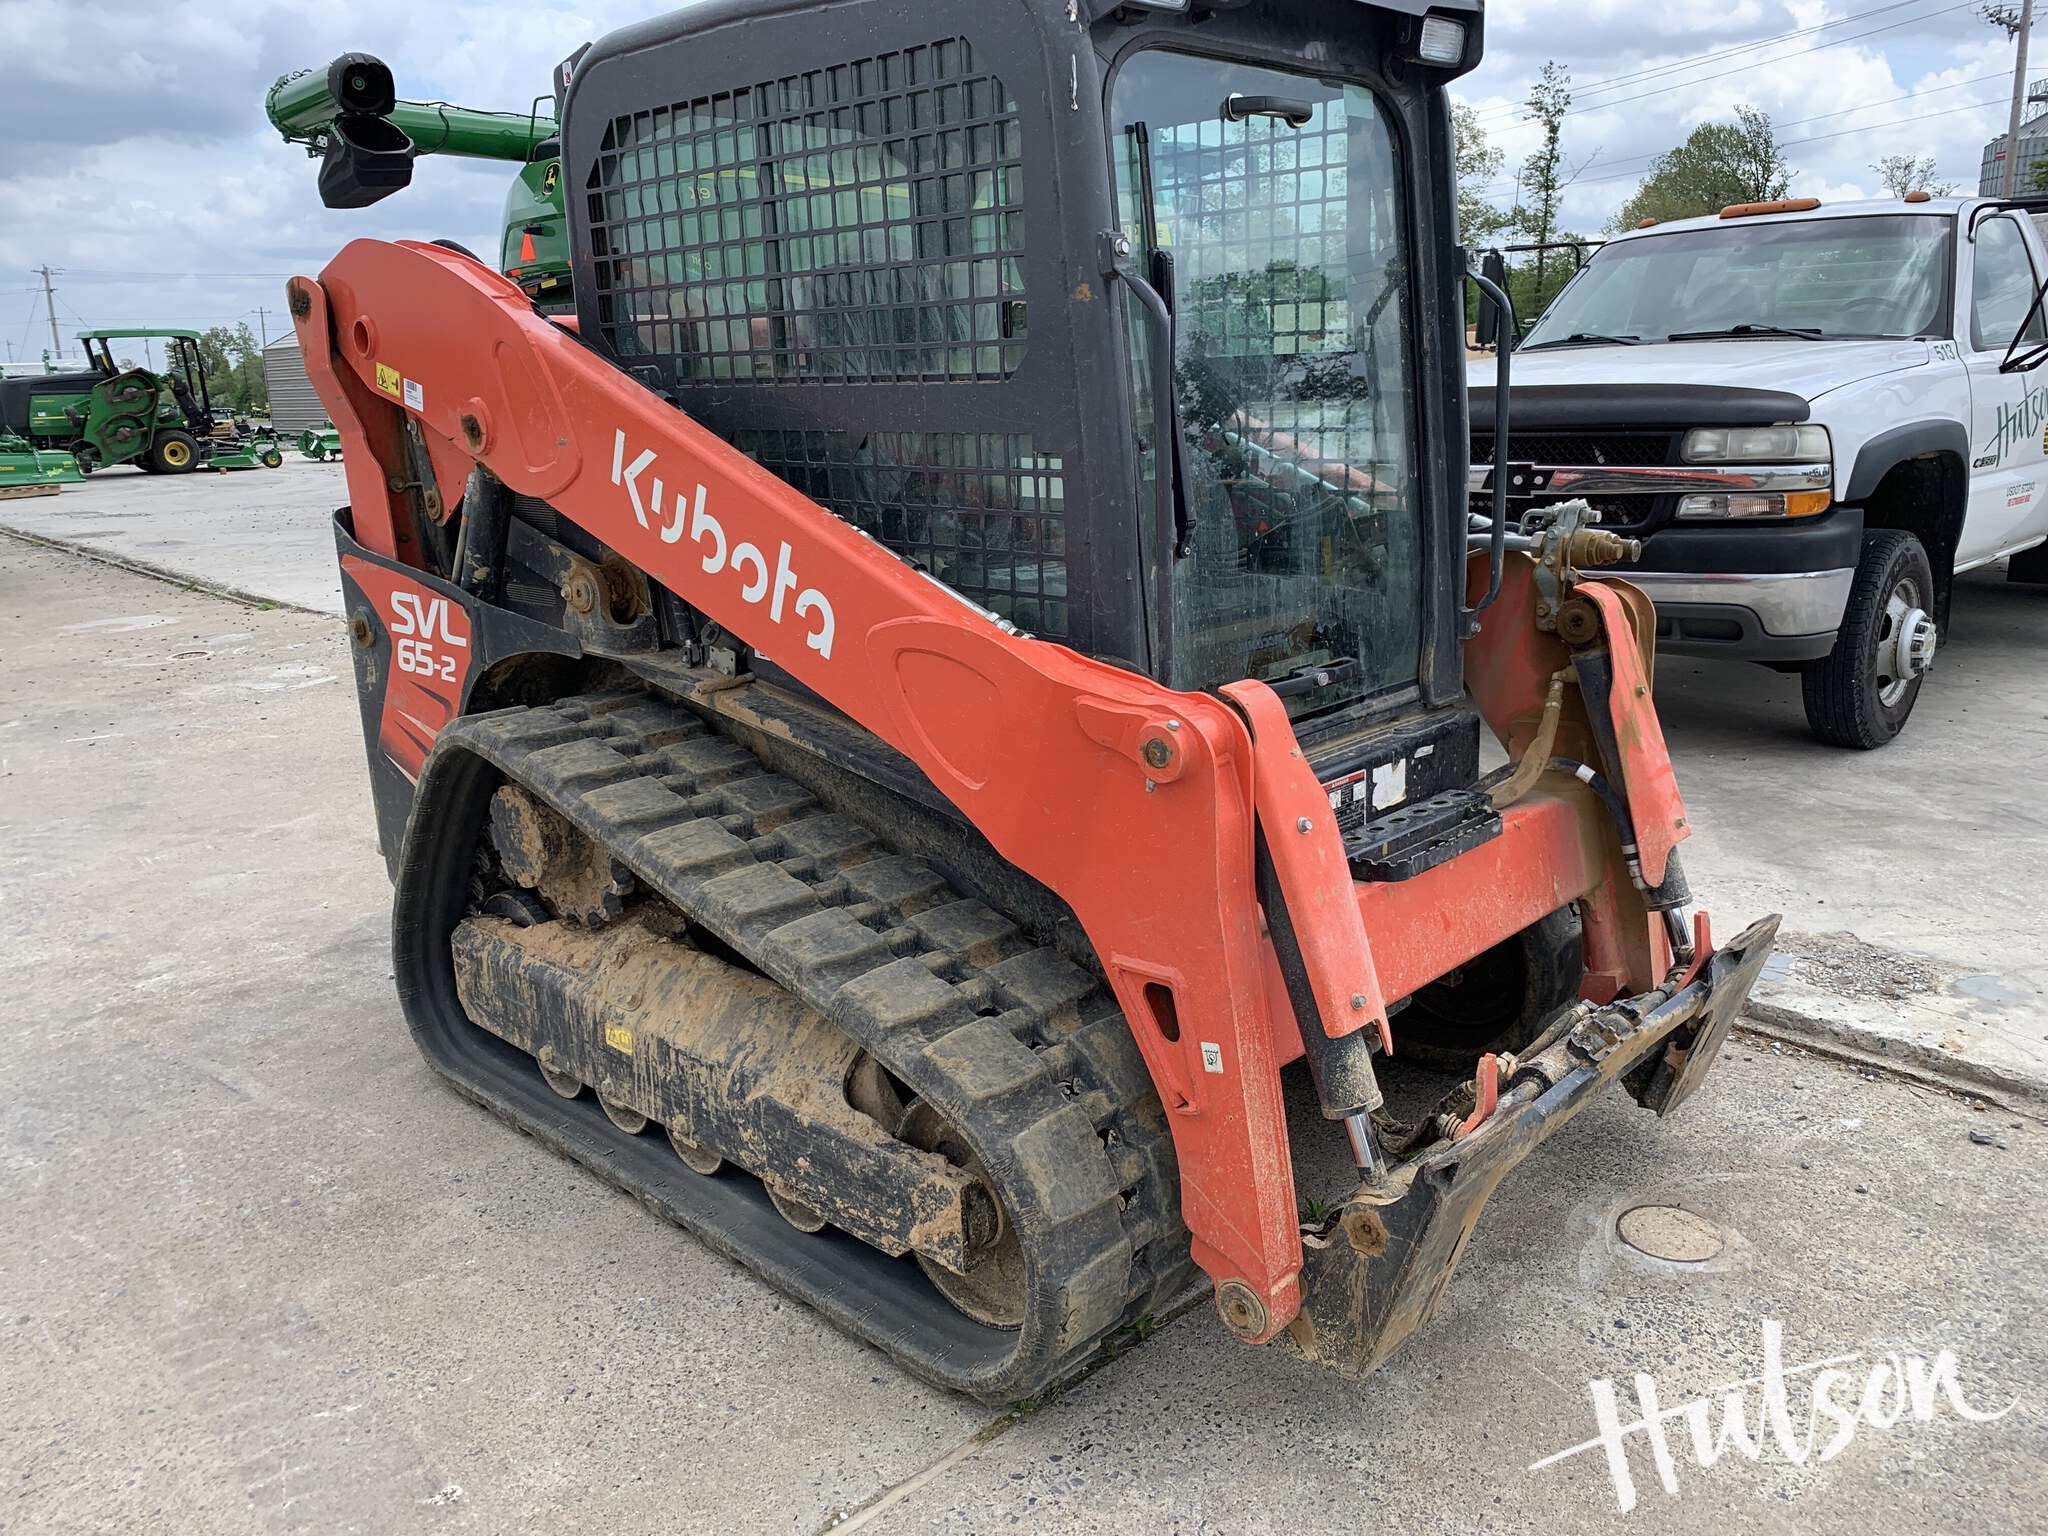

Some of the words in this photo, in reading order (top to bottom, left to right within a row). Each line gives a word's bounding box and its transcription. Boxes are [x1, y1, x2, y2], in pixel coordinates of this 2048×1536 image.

[1933, 343, 1956, 361] 513
[1983, 374, 2048, 469] Hutso
[611, 428, 836, 661] Kubota
[390, 590, 467, 648] SVL
[397, 638, 457, 683] 65-2
